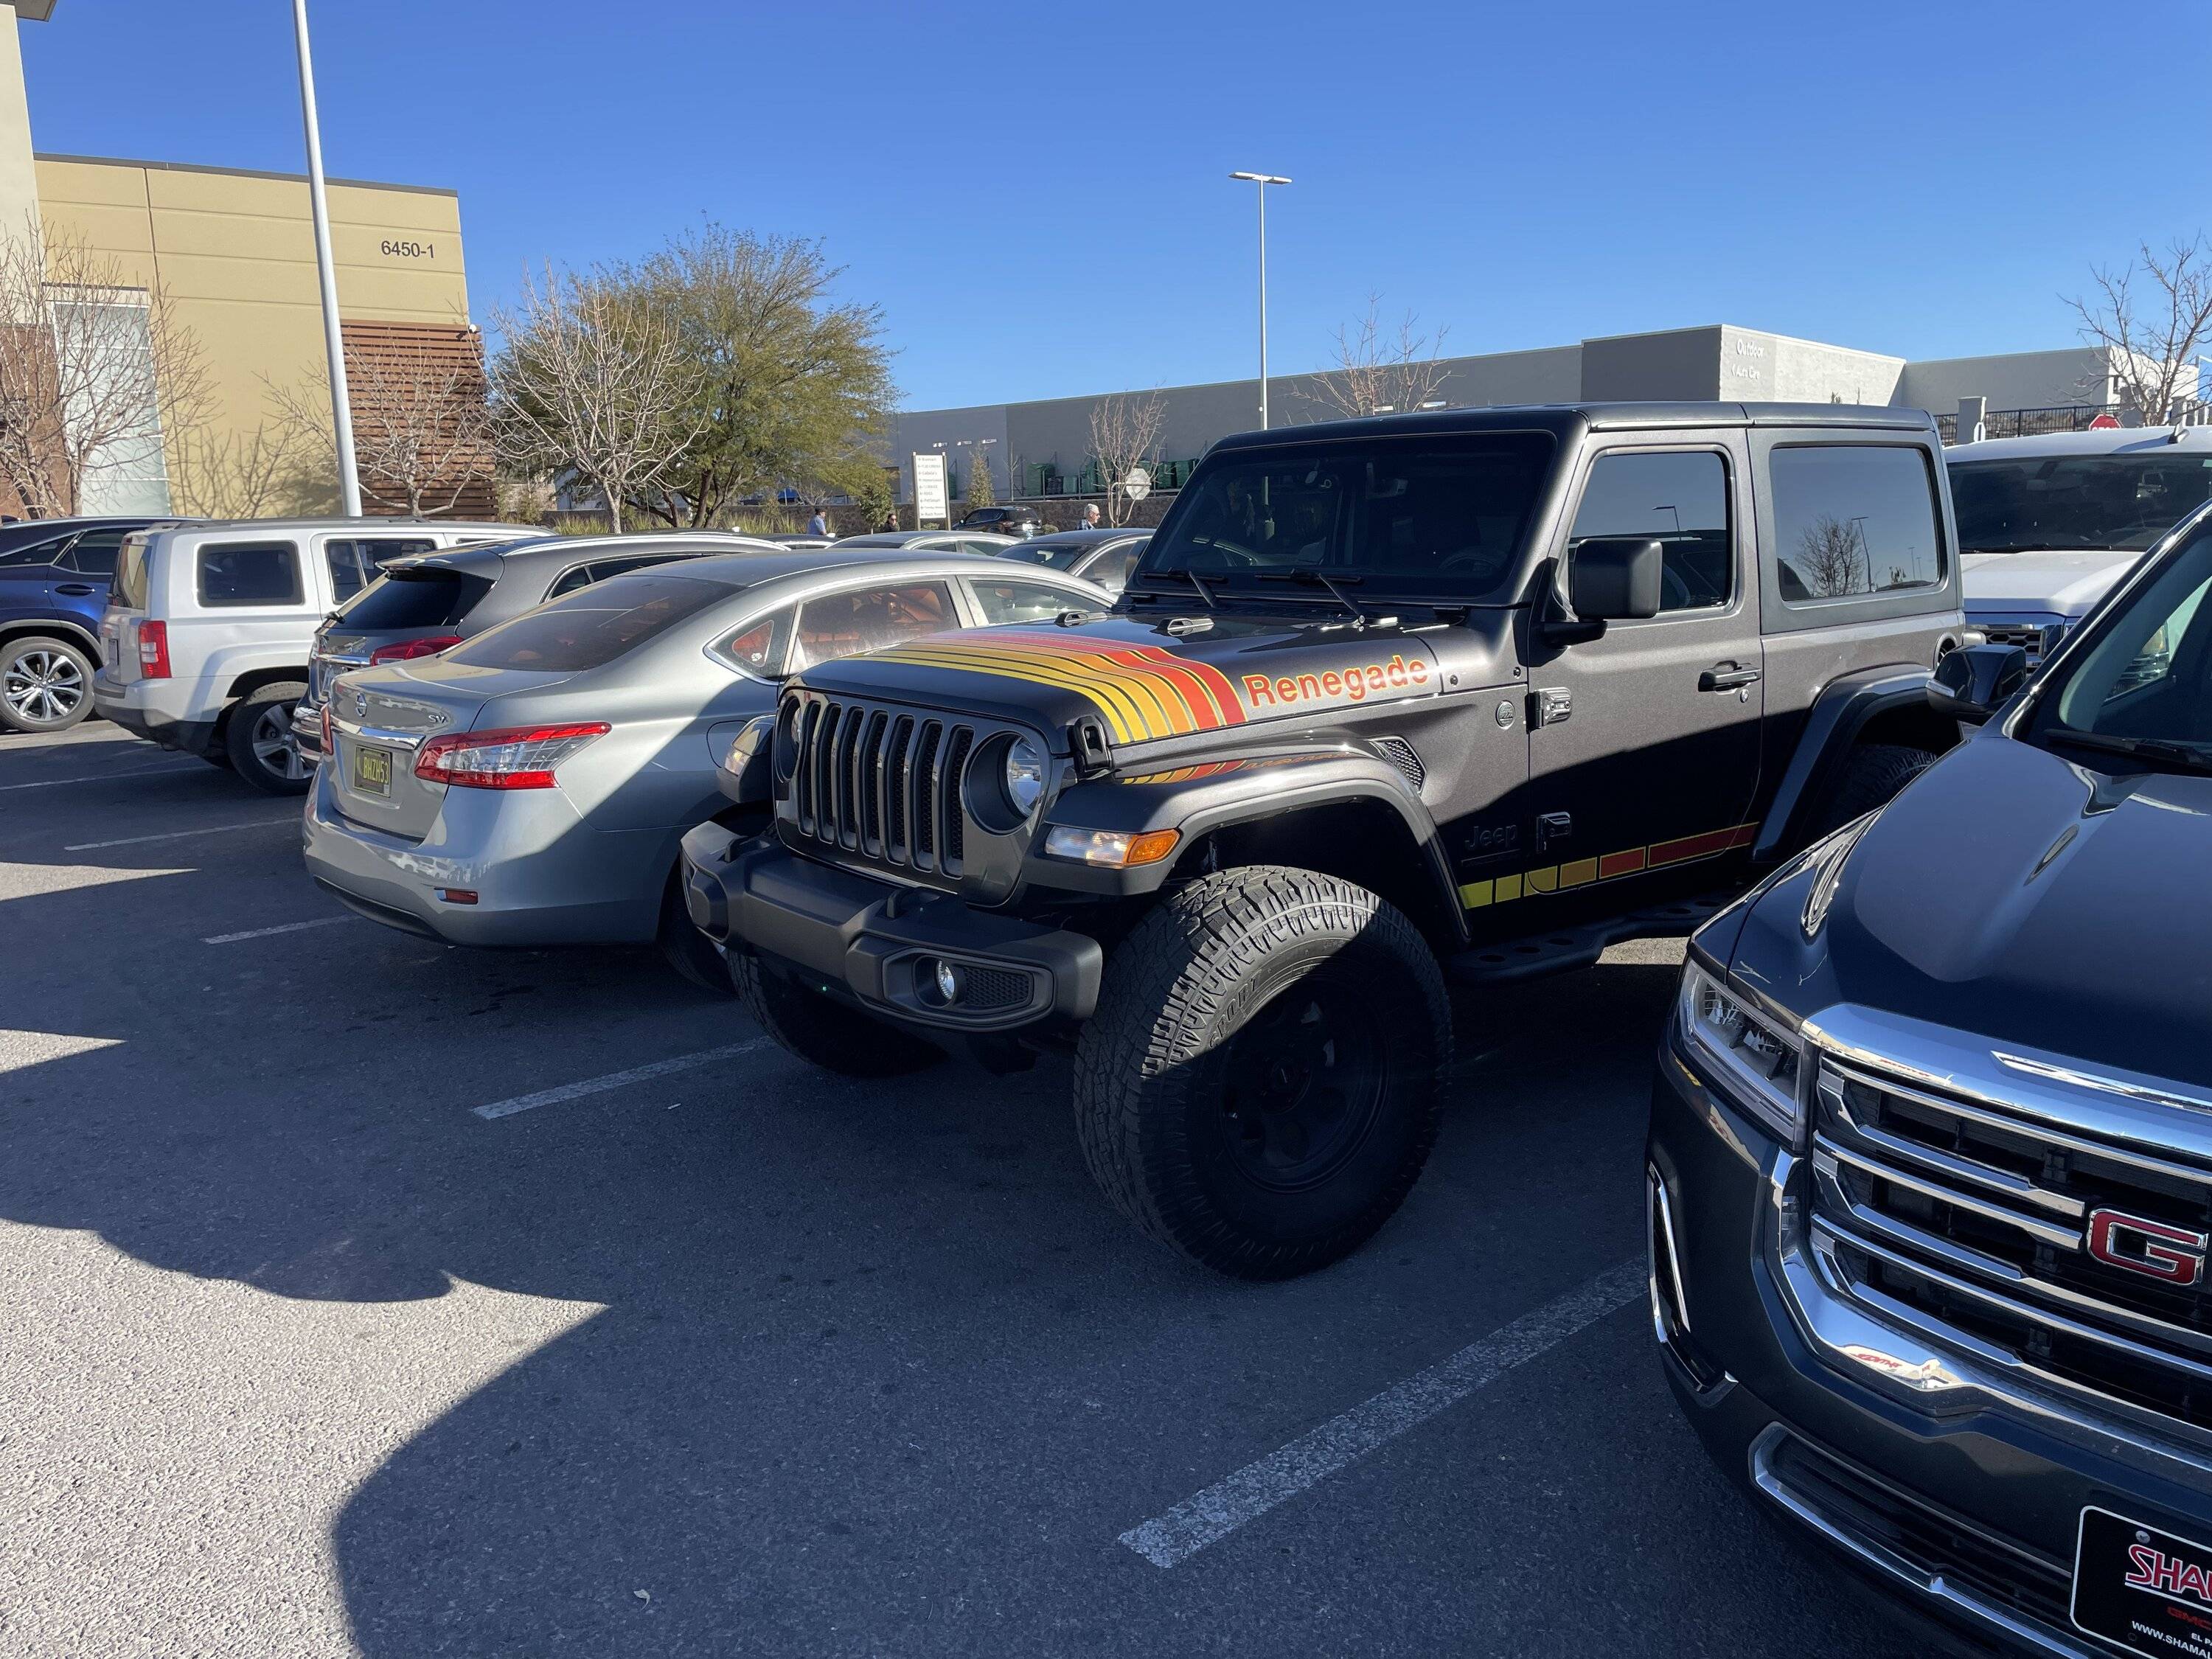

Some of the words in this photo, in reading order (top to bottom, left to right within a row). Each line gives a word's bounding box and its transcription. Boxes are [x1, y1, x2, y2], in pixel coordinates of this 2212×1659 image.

[381, 240, 434, 258] 6450-1
[1242, 655, 1429, 708] Renegade
[1464, 824, 1517, 849] Jeep
[2125, 1544, 2212, 1601] SHA
[2191, 1632, 2203, 1642] EL
[2205, 1638, 2212, 1646] P
